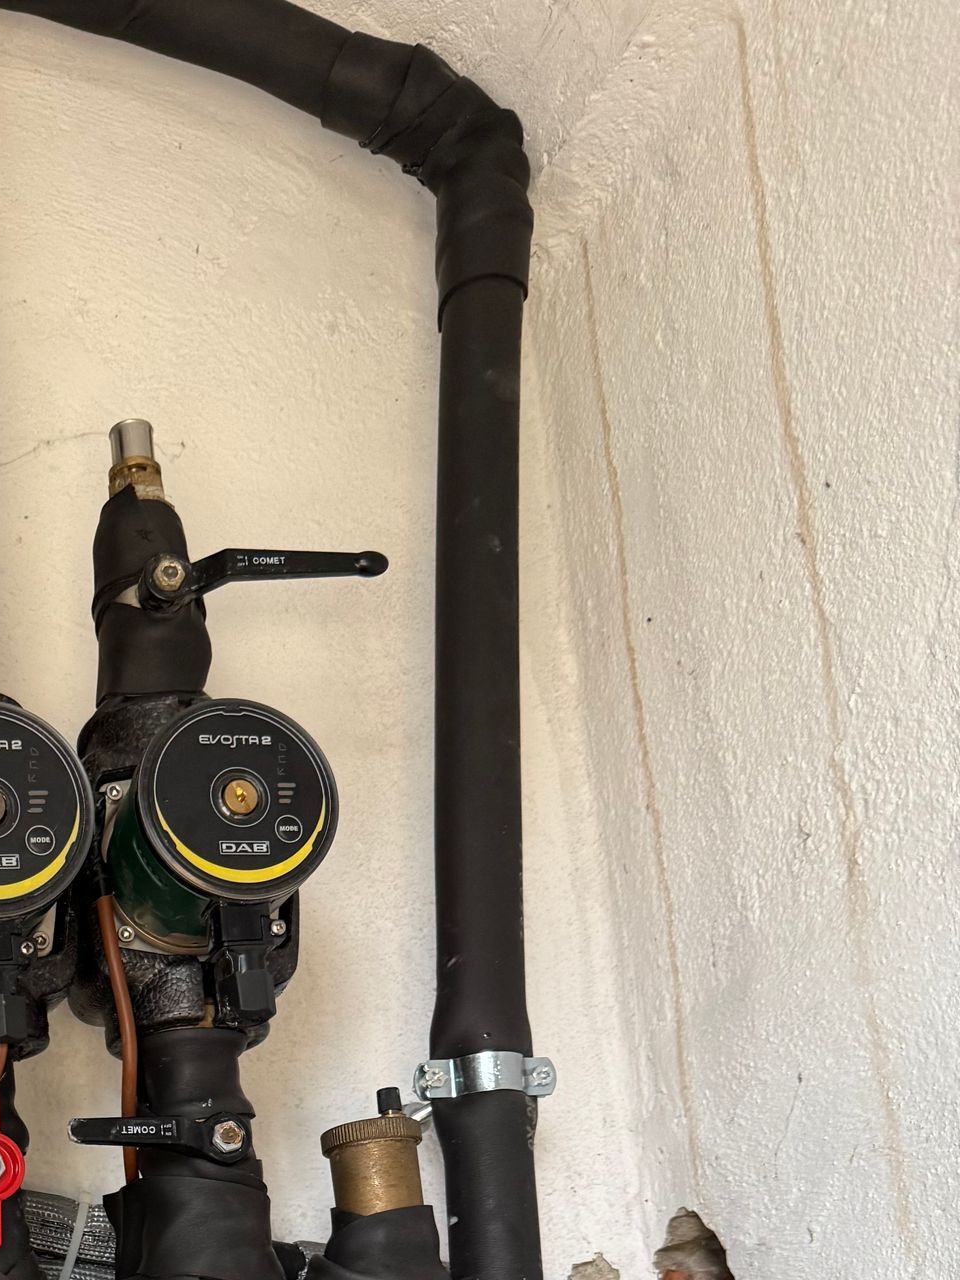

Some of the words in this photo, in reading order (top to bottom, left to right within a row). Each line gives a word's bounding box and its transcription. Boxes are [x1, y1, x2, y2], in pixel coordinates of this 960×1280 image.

[252, 556, 286, 565] COMET
[11, 739, 22, 750] 2
[198, 734, 259, 748] EVOSTA
[261, 736, 272, 745] 2
[221, 843, 267, 853] DAB
[121, 1125, 156, 1134] COMET
